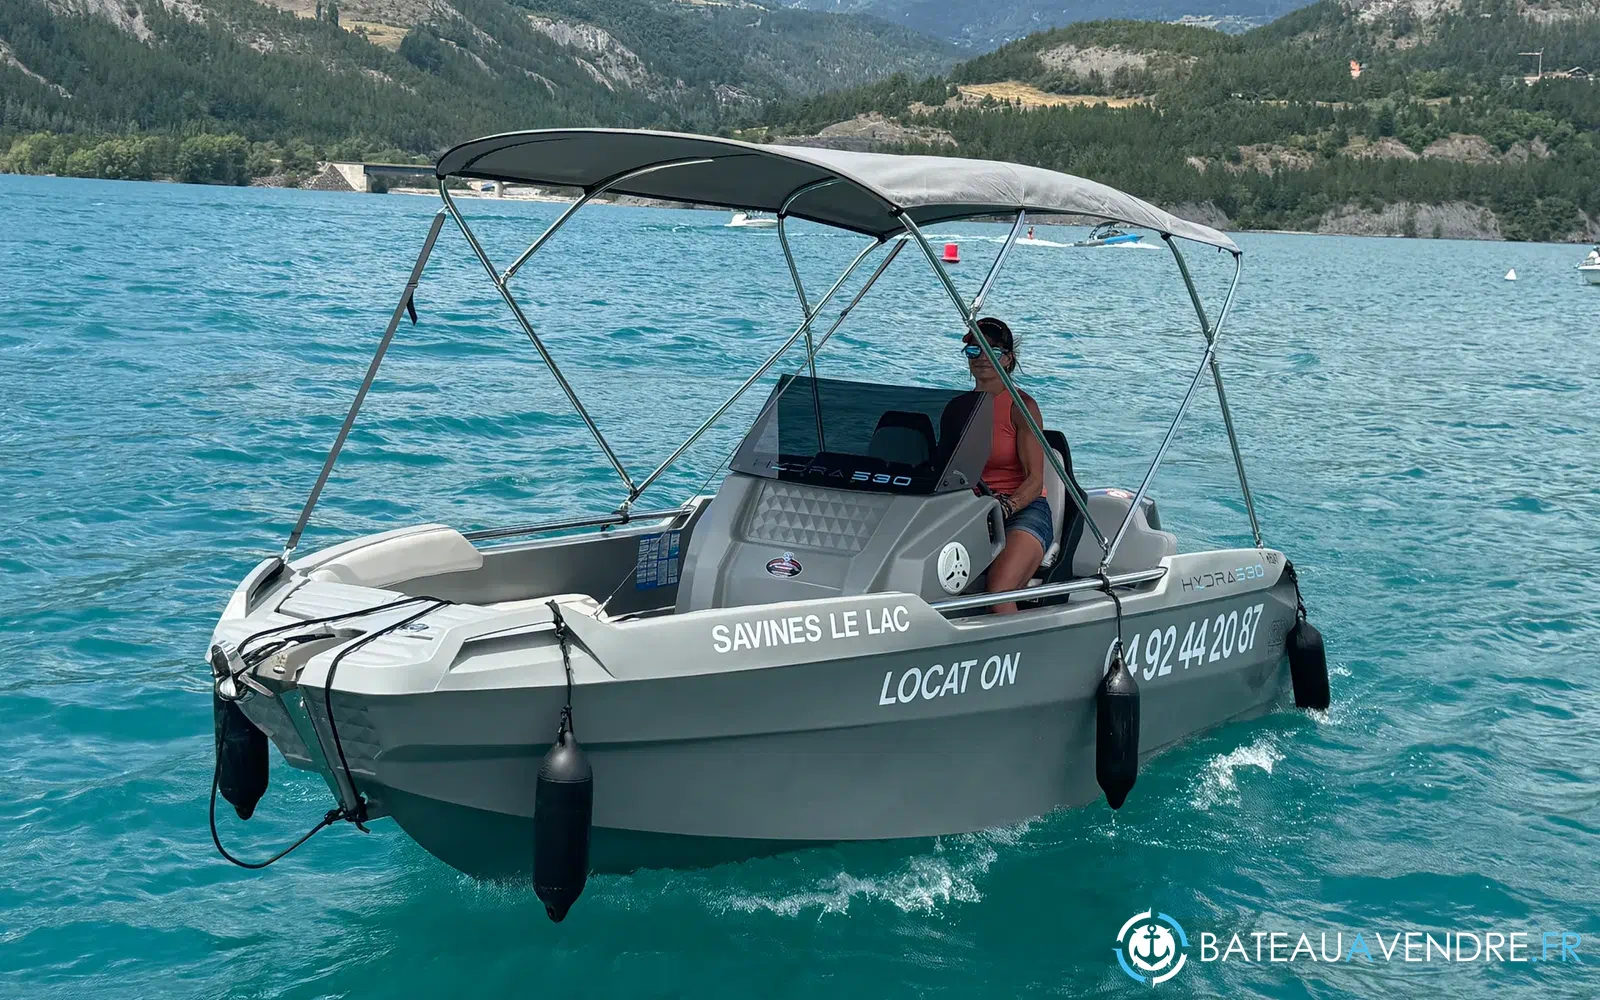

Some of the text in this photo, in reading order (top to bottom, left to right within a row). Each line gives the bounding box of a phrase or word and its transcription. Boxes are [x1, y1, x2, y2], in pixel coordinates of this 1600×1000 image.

[851, 470, 912, 486] 530
[711, 605, 911, 653] SAVINES LE LAC
[1143, 625, 1177, 681] 92
[1178, 618, 1209, 670] 44
[1208, 610, 1238, 663] 20
[1238, 603, 1265, 654] 87
